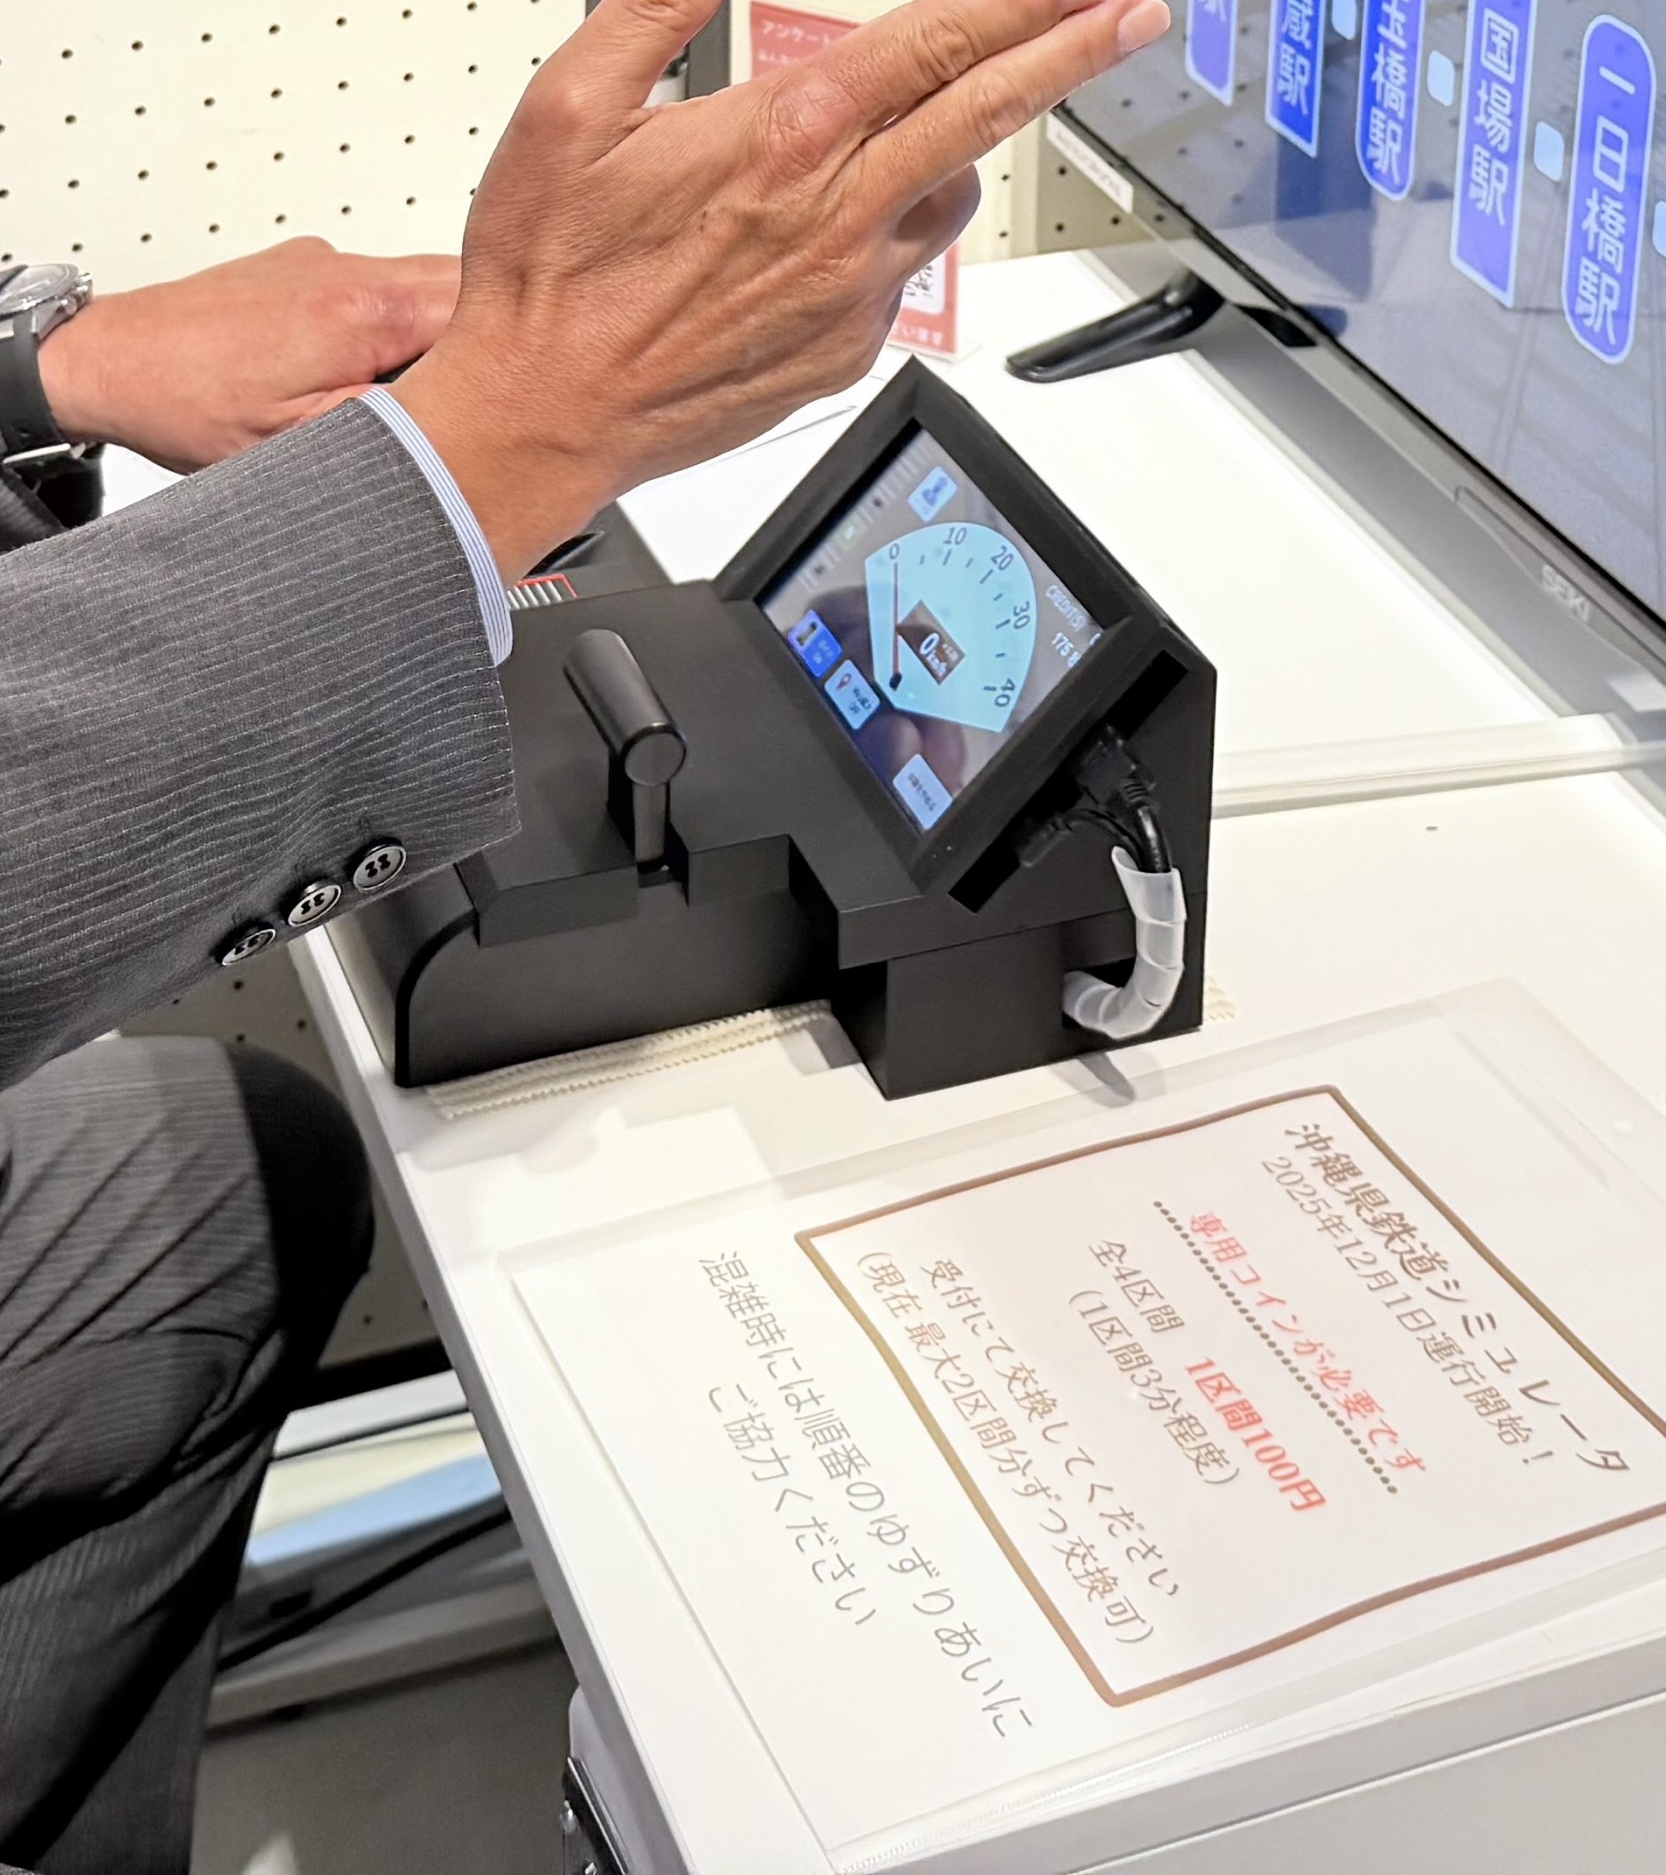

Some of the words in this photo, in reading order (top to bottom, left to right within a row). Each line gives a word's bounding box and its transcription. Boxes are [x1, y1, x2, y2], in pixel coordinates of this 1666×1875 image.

[1467, 7, 1519, 228] 国場駅
[1574, 61, 1636, 346] 一日橋駅
[888, 542, 900, 560] 0
[942, 526, 967, 546] 10
[990, 545, 1015, 571] 20
[1012, 600, 1031, 630] 30
[993, 677, 1016, 708] 40
[1090, 1236, 1185, 1335] 全4区間
[1184, 1356, 1328, 1513] 1区間100円
[1188, 1210, 1427, 1476] 専用コインが必要です
[1284, 1119, 1631, 1478] 沖縄県鉄道シミュレータ
[698, 1249, 1034, 1741] 混雑時には順番のゆずりあいに
[708, 1383, 877, 1627] ご協力ください
[919, 1258, 1181, 1600] 受付にて交換してください
